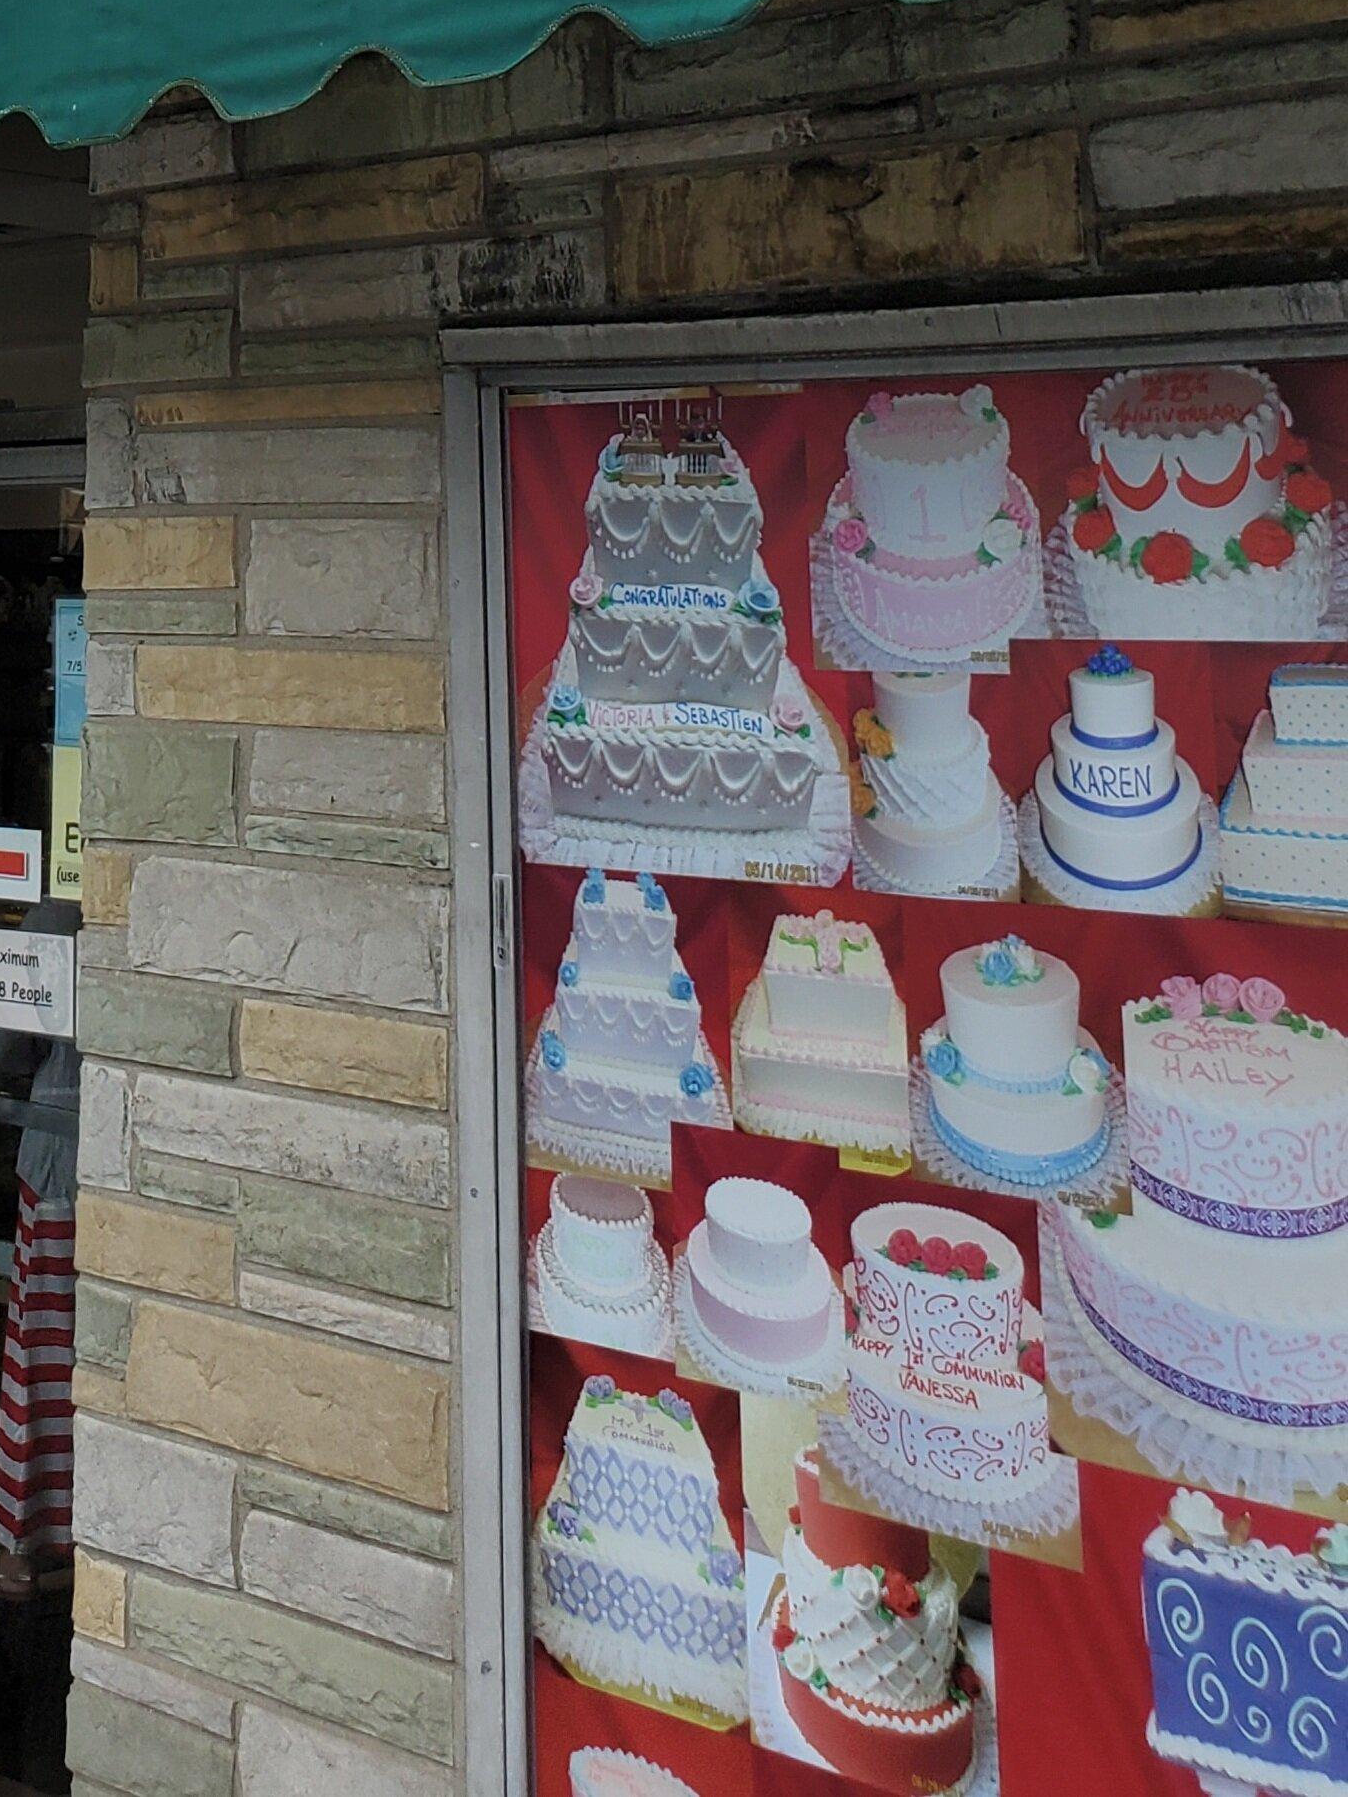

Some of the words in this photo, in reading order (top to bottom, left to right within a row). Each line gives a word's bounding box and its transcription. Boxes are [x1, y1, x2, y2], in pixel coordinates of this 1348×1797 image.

[1069, 759, 1151, 799] KAREN
[56, 865, 80, 885] (use
[12, 981, 53, 1006] People
[851, 1334, 894, 1358] HAPPY
[899, 1371, 980, 1409] VANESSA
